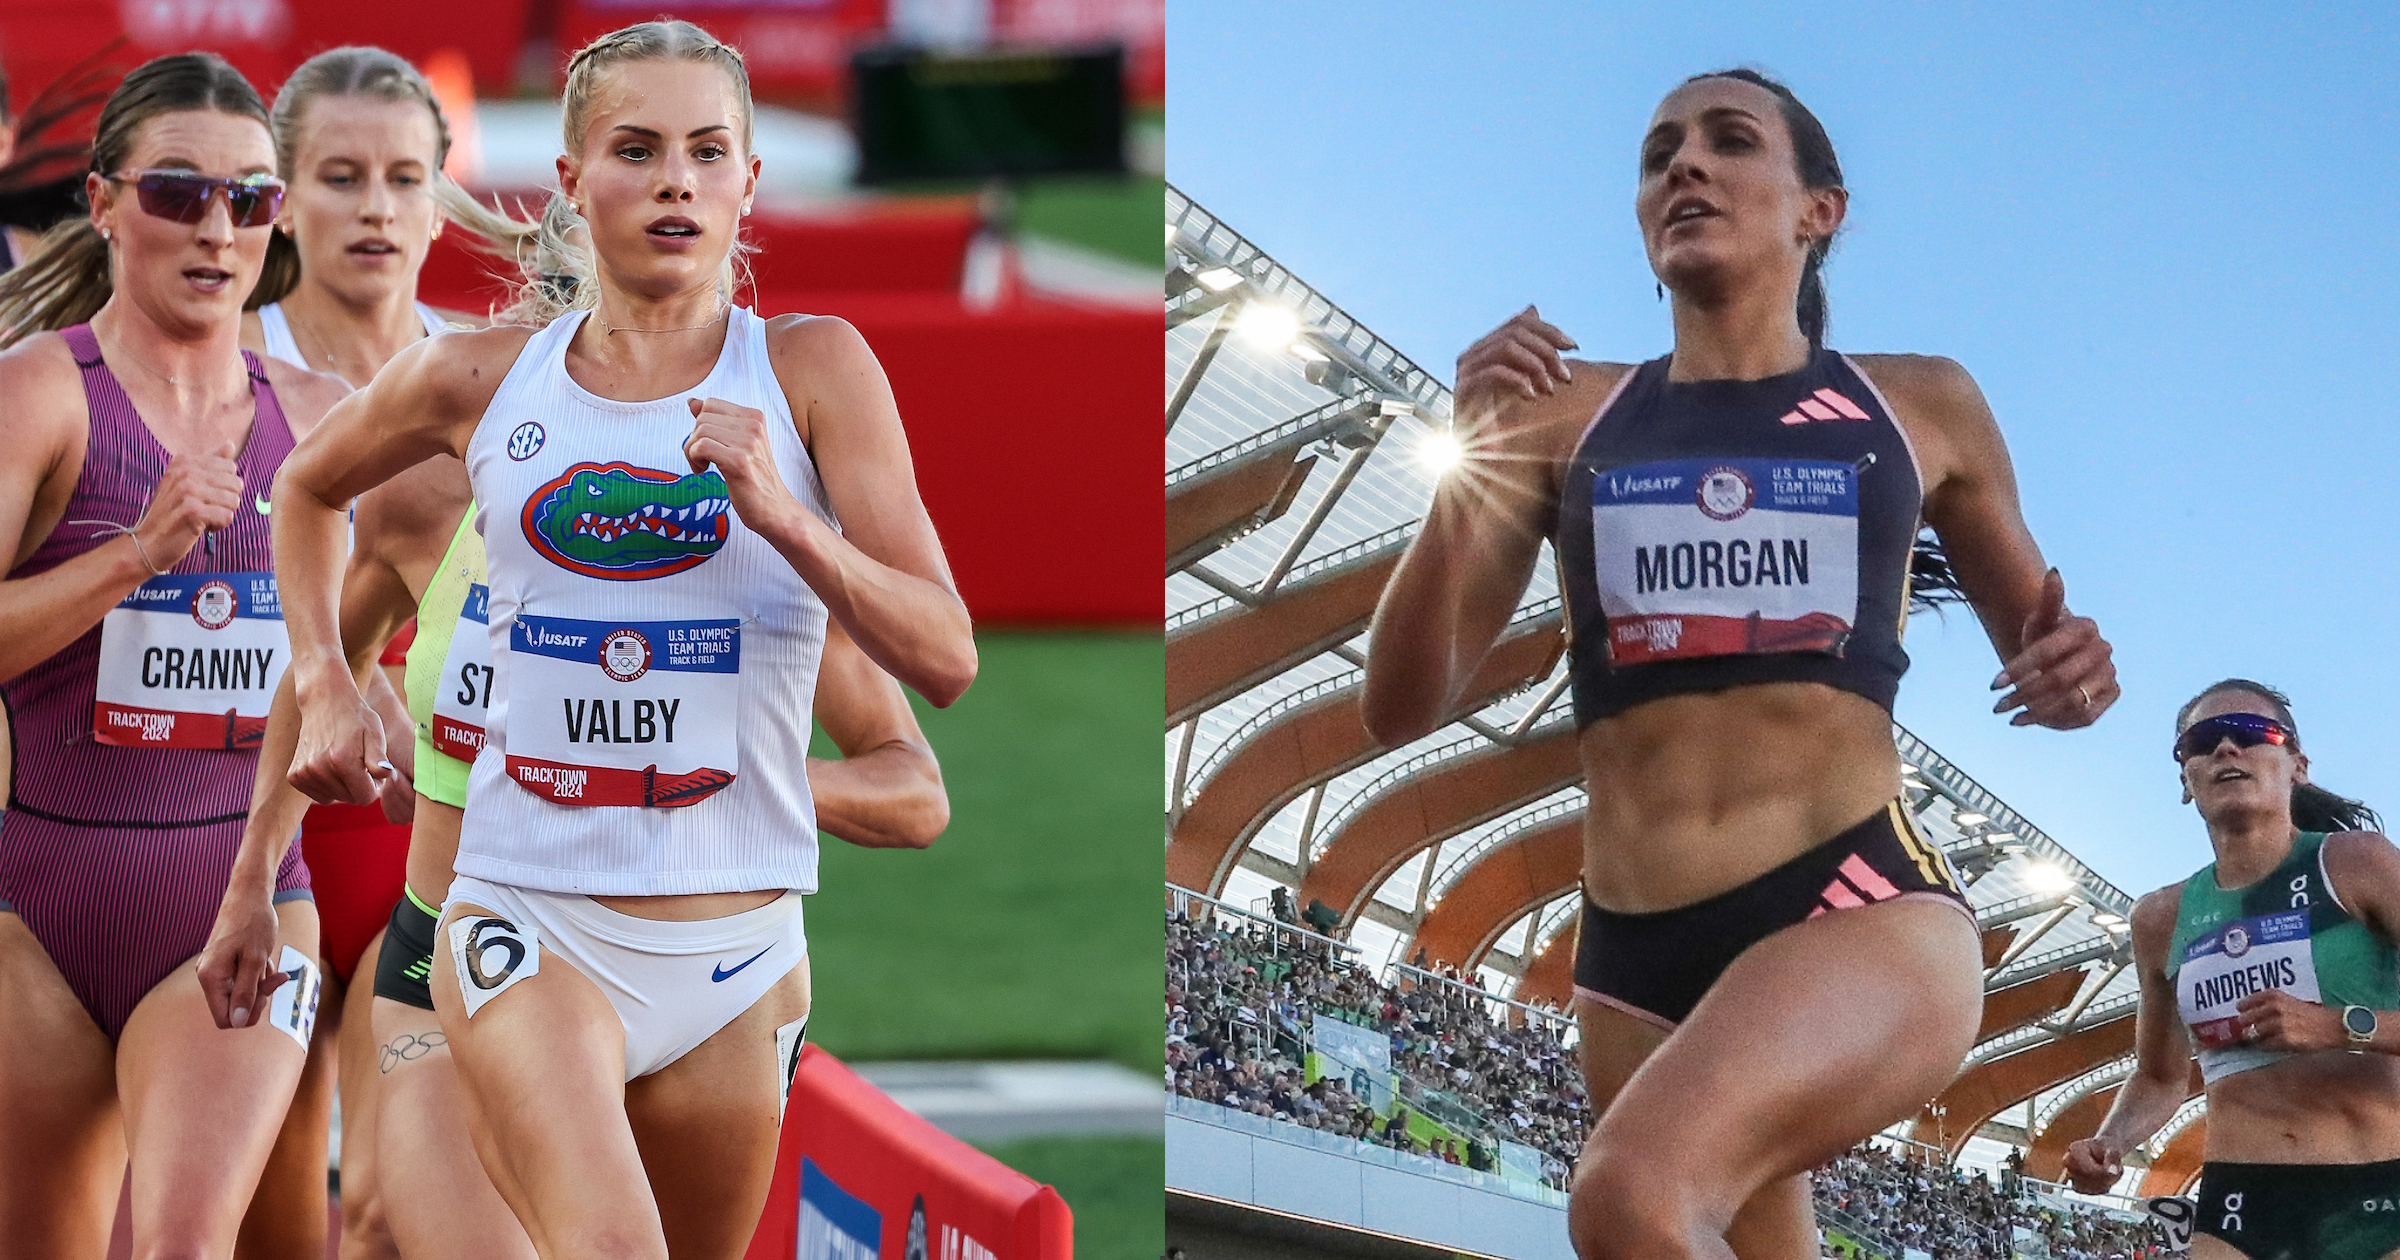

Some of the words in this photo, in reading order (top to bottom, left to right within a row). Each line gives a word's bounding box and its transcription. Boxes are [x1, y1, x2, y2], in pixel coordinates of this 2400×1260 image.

[509, 423, 543, 459] SEC
[1797, 467, 1846, 482] OLYMPIC
[1772, 481, 1803, 494] TEAM
[1807, 481, 1846, 495] TRIALS
[1635, 538, 1809, 593] MORGAN
[140, 589, 182, 600] USATF
[251, 592, 274, 604] TEAM
[545, 634, 588, 648] USATF
[604, 630, 625, 645] UNITED
[627, 630, 647, 645] STATES
[668, 629, 687, 641] U.S.
[689, 628, 730, 641] OLYMPIC
[668, 643, 694, 655] TEAM
[697, 642, 730, 654] TRIALS
[142, 646, 274, 690] CRANNY
[669, 656, 691, 665] TRACK
[698, 656, 715, 664] FIELD
[107, 711, 175, 730] TRACKTOWN
[563, 698, 681, 744] VALBY
[141, 727, 171, 741] 2024
[517, 766, 587, 786] TRACKTOWN
[553, 781, 583, 798] 2024
[465, 918, 525, 990] 6
[2194, 956, 2296, 1011] ANDREWS
